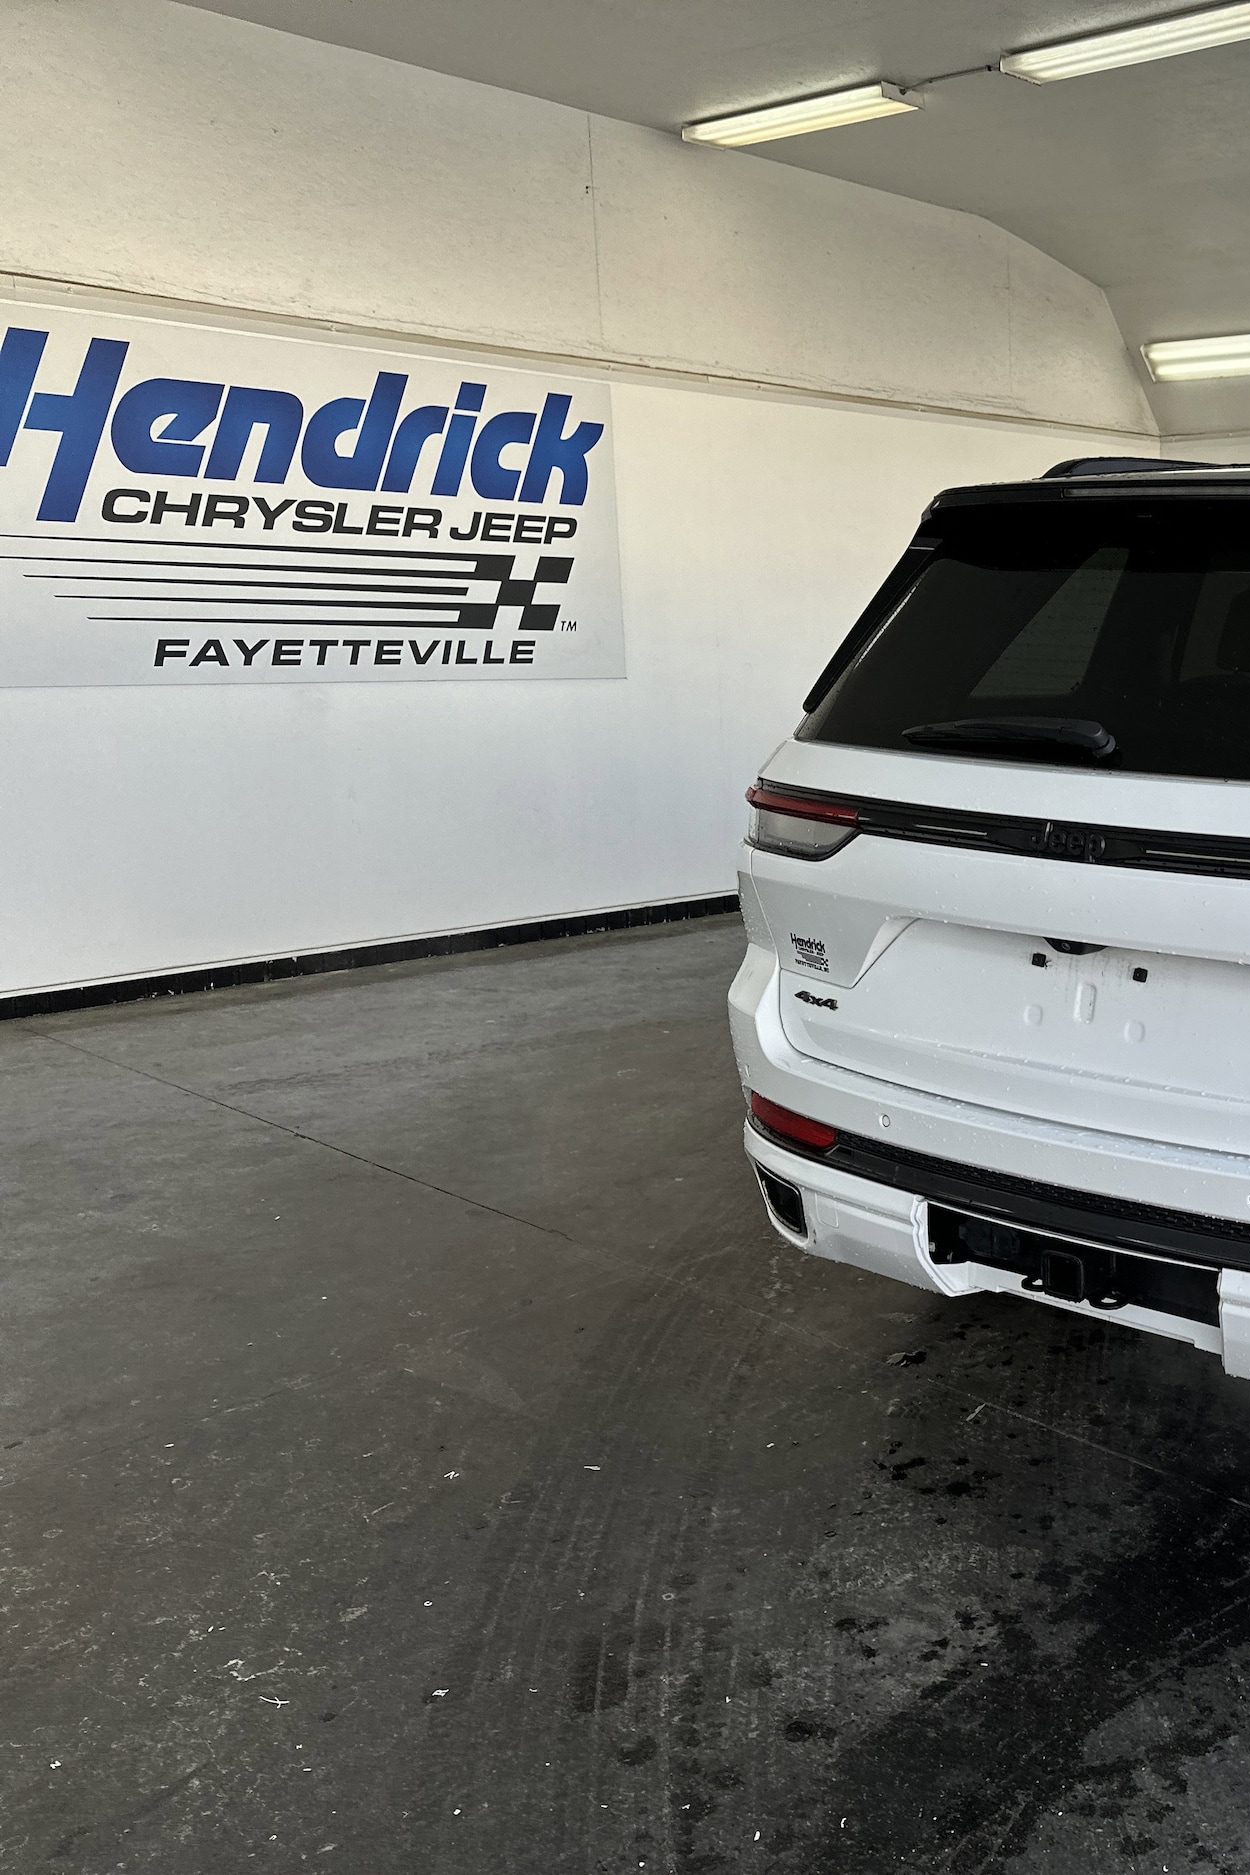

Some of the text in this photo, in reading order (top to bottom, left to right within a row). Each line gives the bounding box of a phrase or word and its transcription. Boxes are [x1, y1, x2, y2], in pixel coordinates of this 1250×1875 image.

[0, 327, 604, 523] Hendrick
[101, 488, 578, 545] CHRYSLER JEEP
[153, 638, 536, 667] FAYETTEVILLE
[1030, 821, 1106, 863] Jeep
[790, 932, 826, 953] Hendrick
[794, 990, 839, 1011] 4x4
